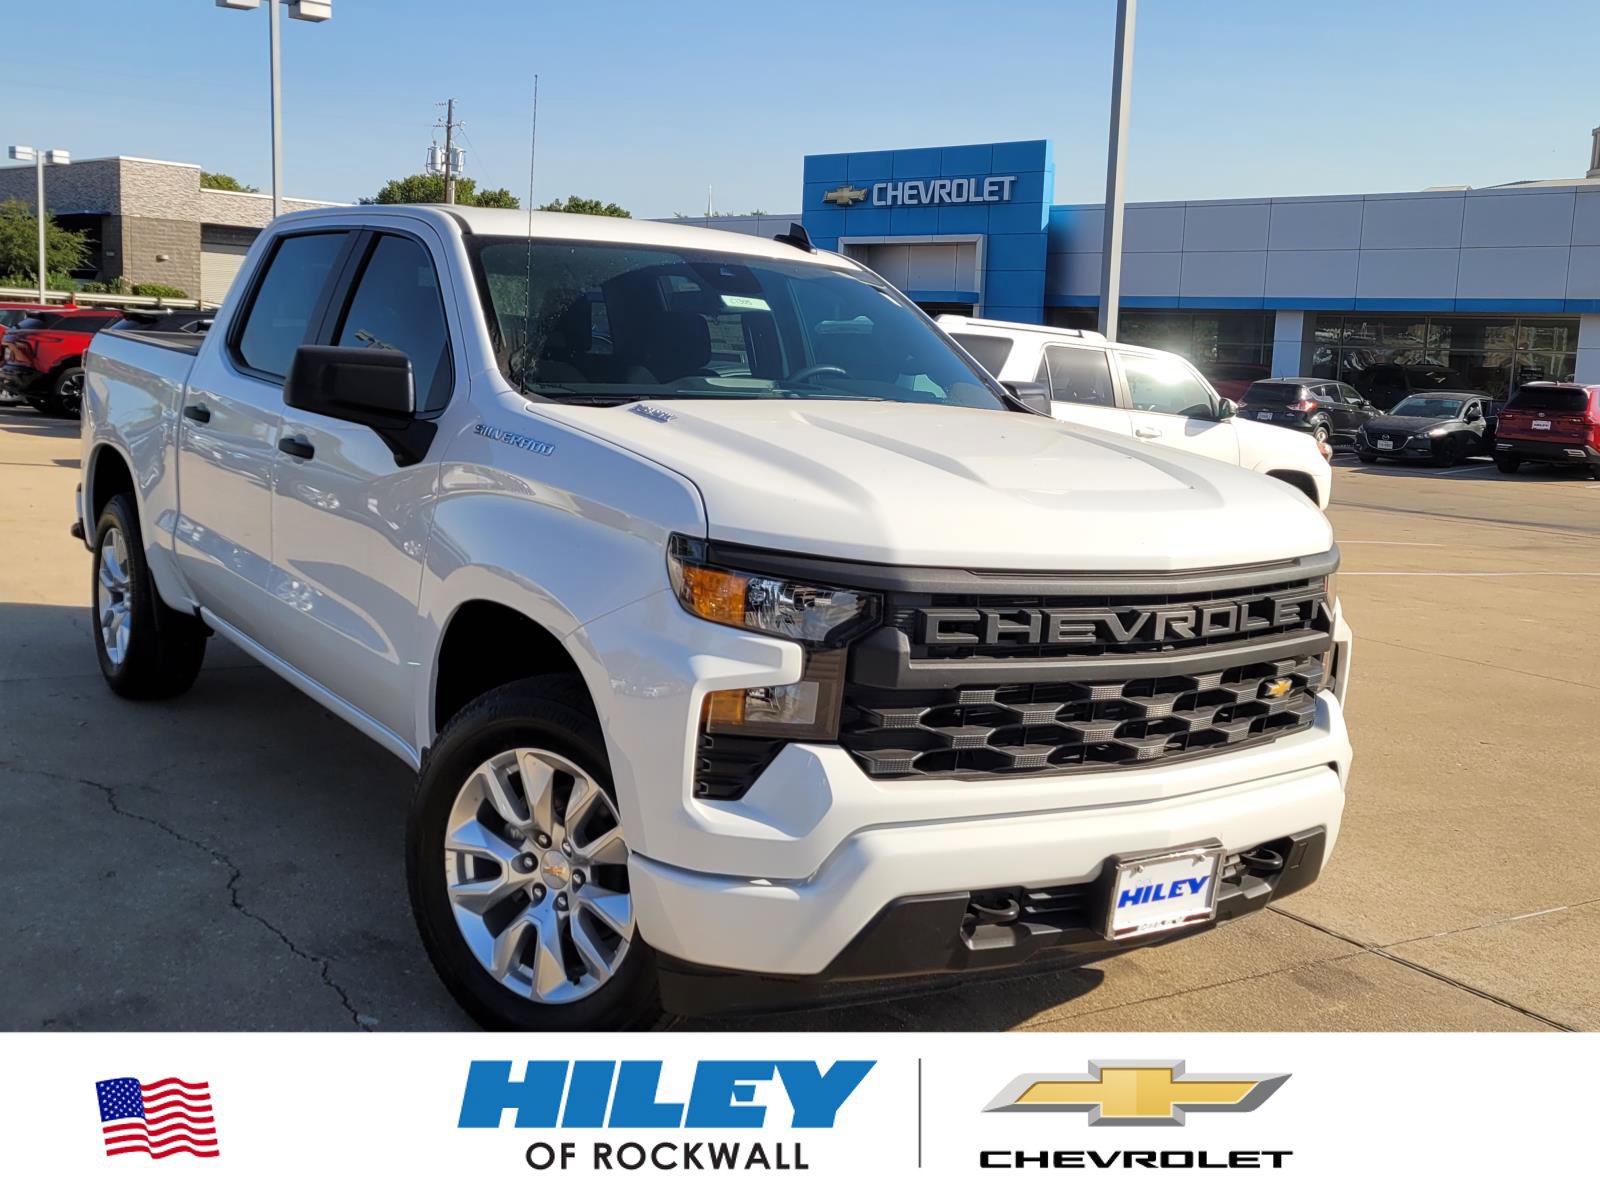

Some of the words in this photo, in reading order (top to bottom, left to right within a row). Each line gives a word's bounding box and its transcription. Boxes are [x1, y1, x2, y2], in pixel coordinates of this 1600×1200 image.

[872, 175, 1017, 206] CHEVROLET
[473, 424, 556, 457] SILVERADO
[922, 592, 1327, 645] CHEVROLET
[1117, 875, 1210, 908] HILEY
